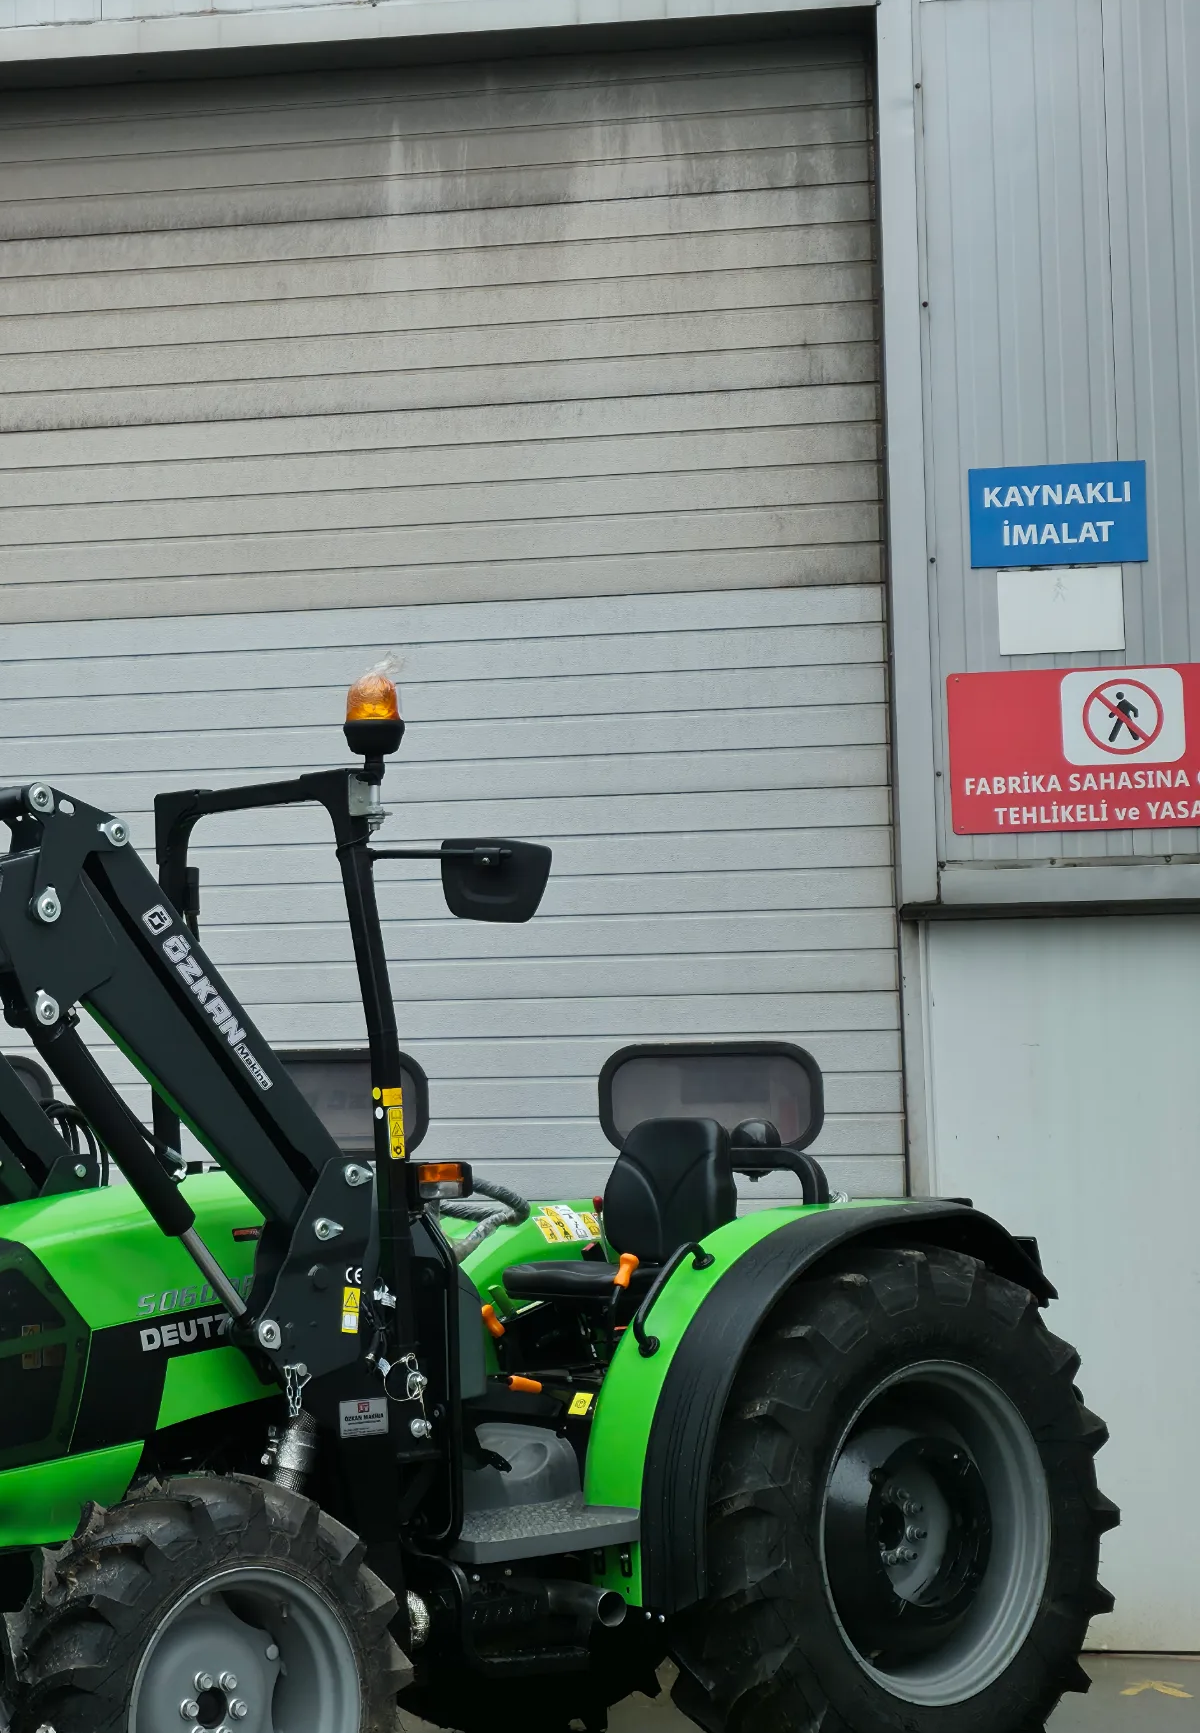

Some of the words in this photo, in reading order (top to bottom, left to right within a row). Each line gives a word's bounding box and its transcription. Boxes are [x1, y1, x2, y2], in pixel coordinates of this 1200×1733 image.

[983, 481, 1132, 509] KAYNAKLI
[1003, 520, 1115, 547] İMALAT
[965, 771, 1062, 796] FABRİKA
[1069, 769, 1191, 792] SAHASINA
[994, 799, 1109, 826] TEHLİKELİ
[1114, 806, 1140, 821] ve
[162, 934, 247, 1046] ÖZKAN
[236, 1045, 270, 1089] Makina
[345, 1267, 362, 1284] CE
